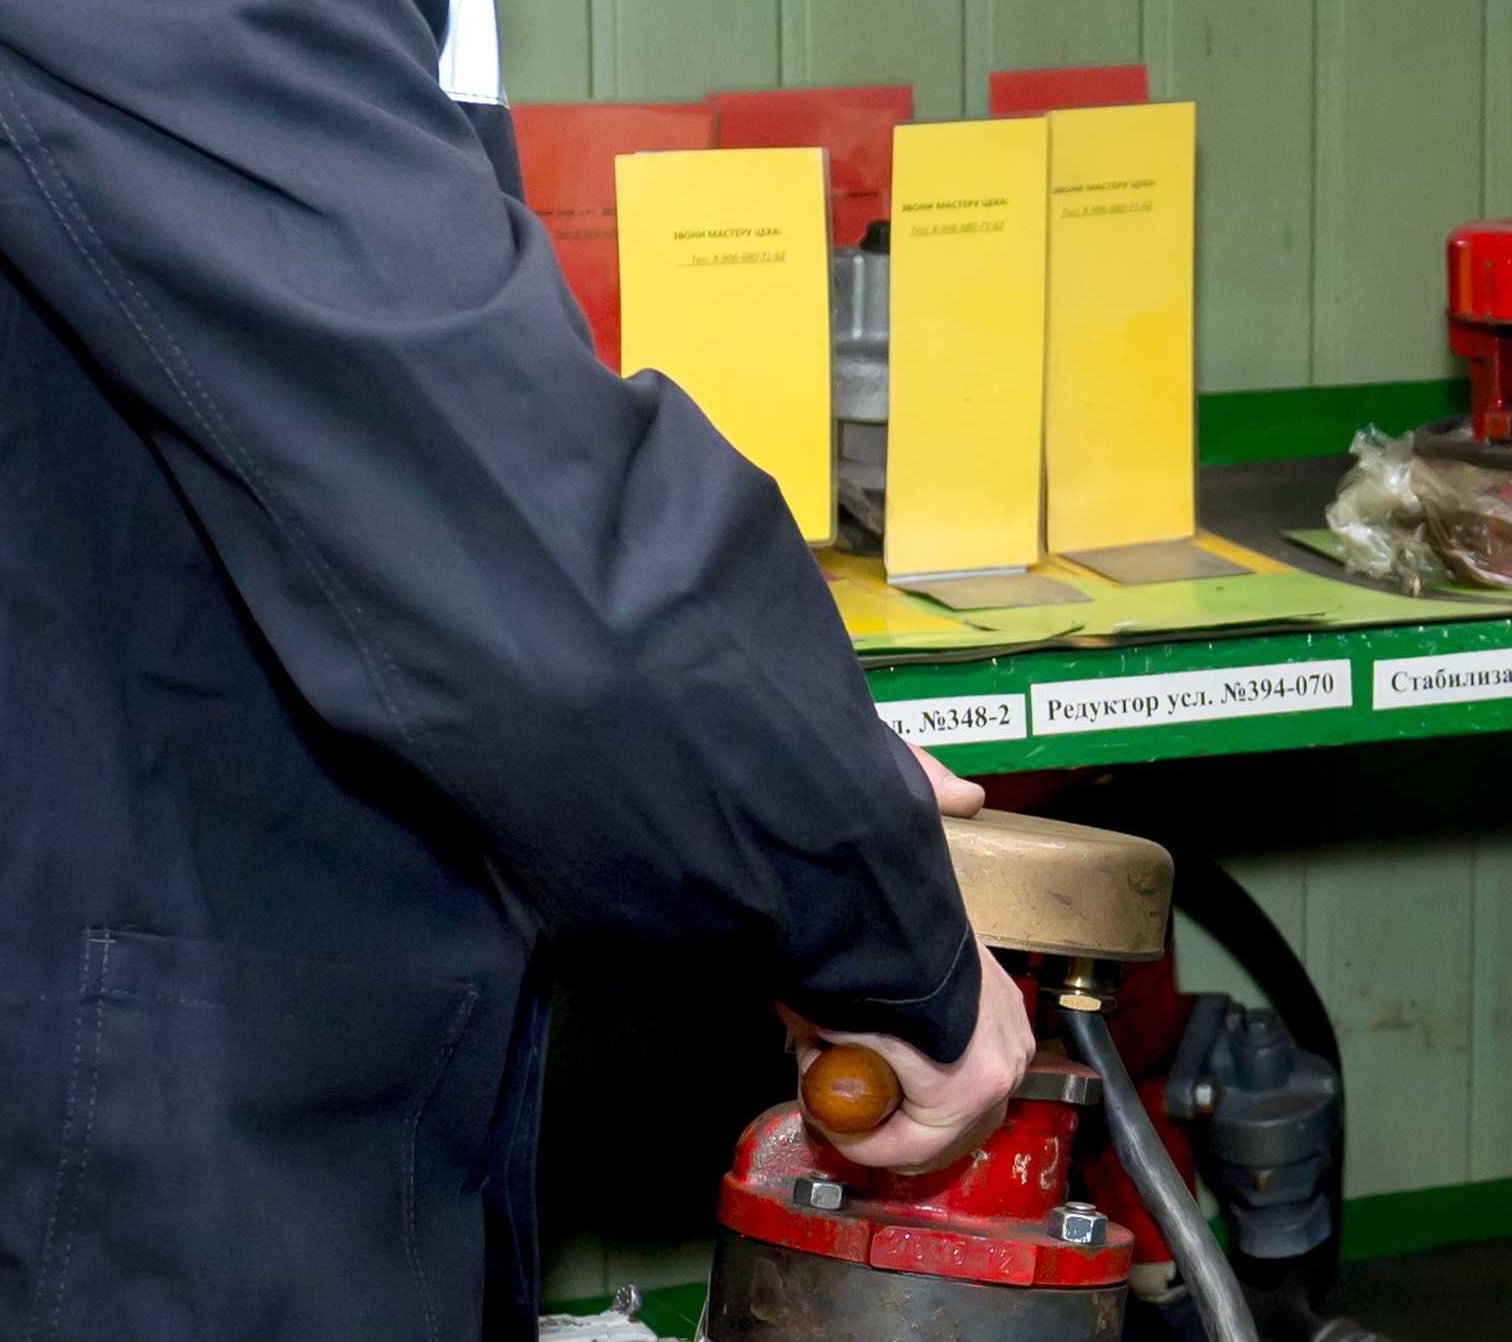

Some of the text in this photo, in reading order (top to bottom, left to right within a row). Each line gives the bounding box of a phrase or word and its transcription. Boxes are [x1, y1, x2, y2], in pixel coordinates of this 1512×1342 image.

[1046, 671, 1335, 723] Редуктор усл. №394-070
[919, 703, 1011, 733] №348-2
